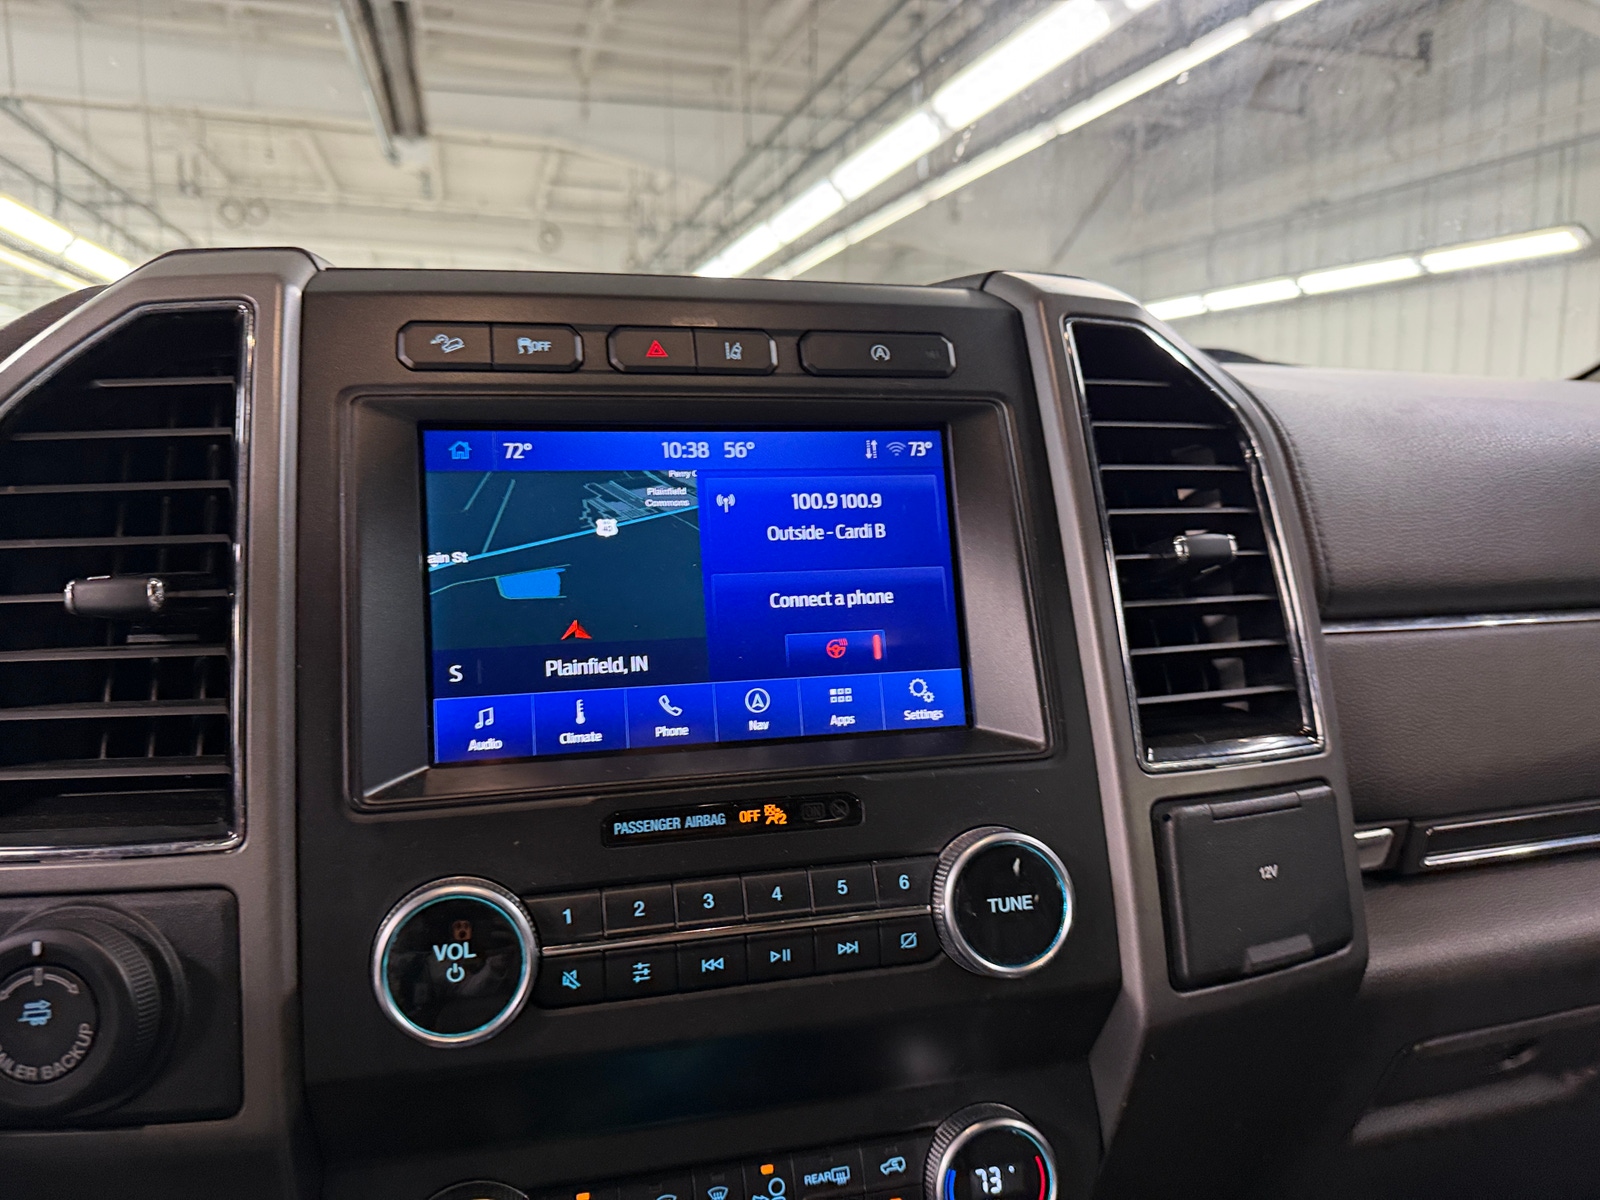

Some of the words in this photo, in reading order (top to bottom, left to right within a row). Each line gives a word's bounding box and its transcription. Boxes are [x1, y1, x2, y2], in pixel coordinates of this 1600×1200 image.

[661, 441, 710, 459] 10:38
[723, 441, 755, 459] 56°
[791, 493, 838, 510] 100.9
[841, 493, 882, 509] 100.9
[767, 525, 824, 541] Outside
[835, 523, 873, 540] Cardi
[875, 523, 887, 539] B
[451, 551, 469, 564] St
[769, 591, 833, 609] Connect
[834, 594, 845, 606] a
[847, 589, 894, 608] phone
[448, 664, 464, 683] S
[545, 656, 628, 677] Plainfield,
[630, 655, 649, 673] IN
[830, 714, 856, 728] Apps
[904, 708, 944, 722] Settings
[655, 726, 689, 738] Phone
[748, 720, 770, 732] Nav
[468, 738, 503, 752] Audio
[559, 732, 603, 746] Climate
[613, 816, 682, 836] PASSENGER
[684, 812, 727, 829] AIRBAG
[738, 809, 761, 824] OFF
[1258, 864, 1279, 880] 12V
[837, 879, 848, 895] 5
[899, 874, 911, 890] 6
[702, 893, 715, 909] 3
[771, 886, 783, 901] 4
[633, 900, 646, 917] 2
[987, 894, 1034, 913] TUNE
[562, 908, 573, 925] 1
[432, 941, 477, 962] VOL
[0, 1043, 38, 1080] AILER
[40, 1023, 94, 1080] BACKUP
[804, 1171, 832, 1186] REAR
